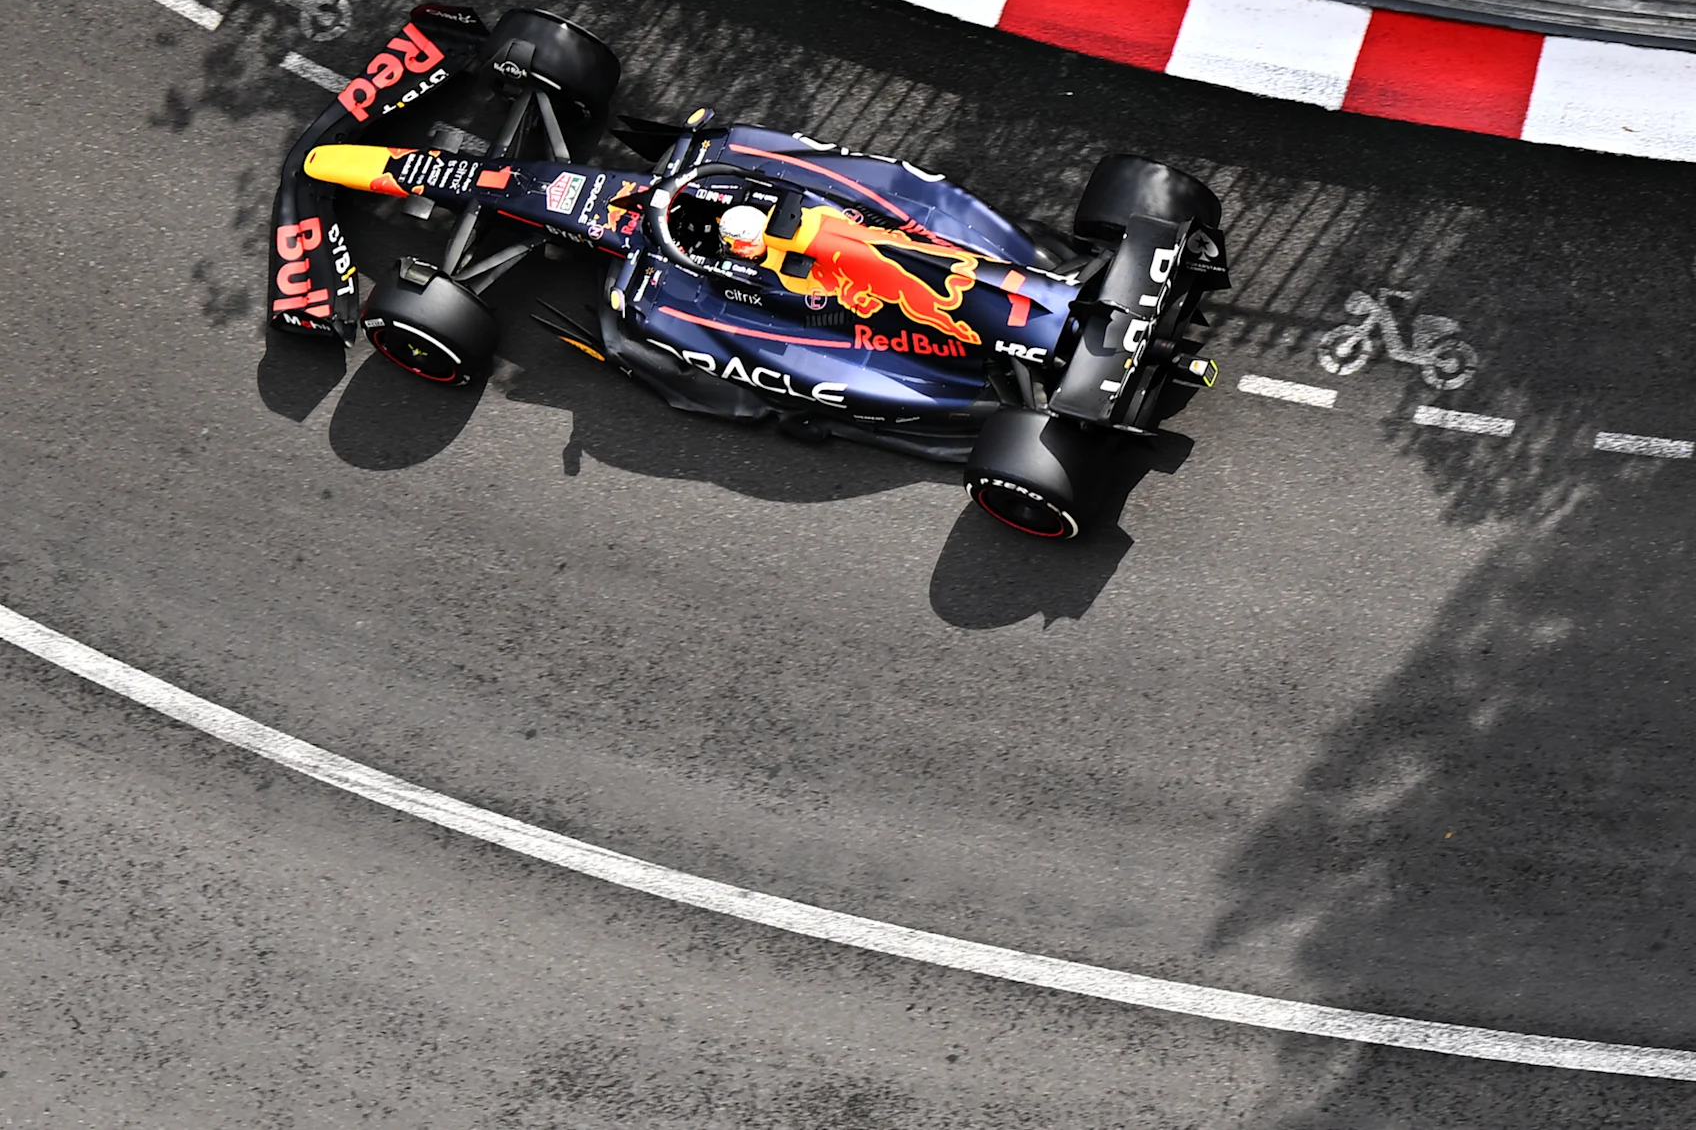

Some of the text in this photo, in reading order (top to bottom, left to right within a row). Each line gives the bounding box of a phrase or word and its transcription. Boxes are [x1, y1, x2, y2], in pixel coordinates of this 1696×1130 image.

[338, 22, 445, 122] Red
[578, 173, 607, 225] ORACLE
[273, 217, 331, 318] Bull
[328, 223, 357, 296] BYBIT
[724, 288, 764, 307] citrix
[854, 324, 967, 357] Red Bull
[995, 339, 1048, 363] HRC
